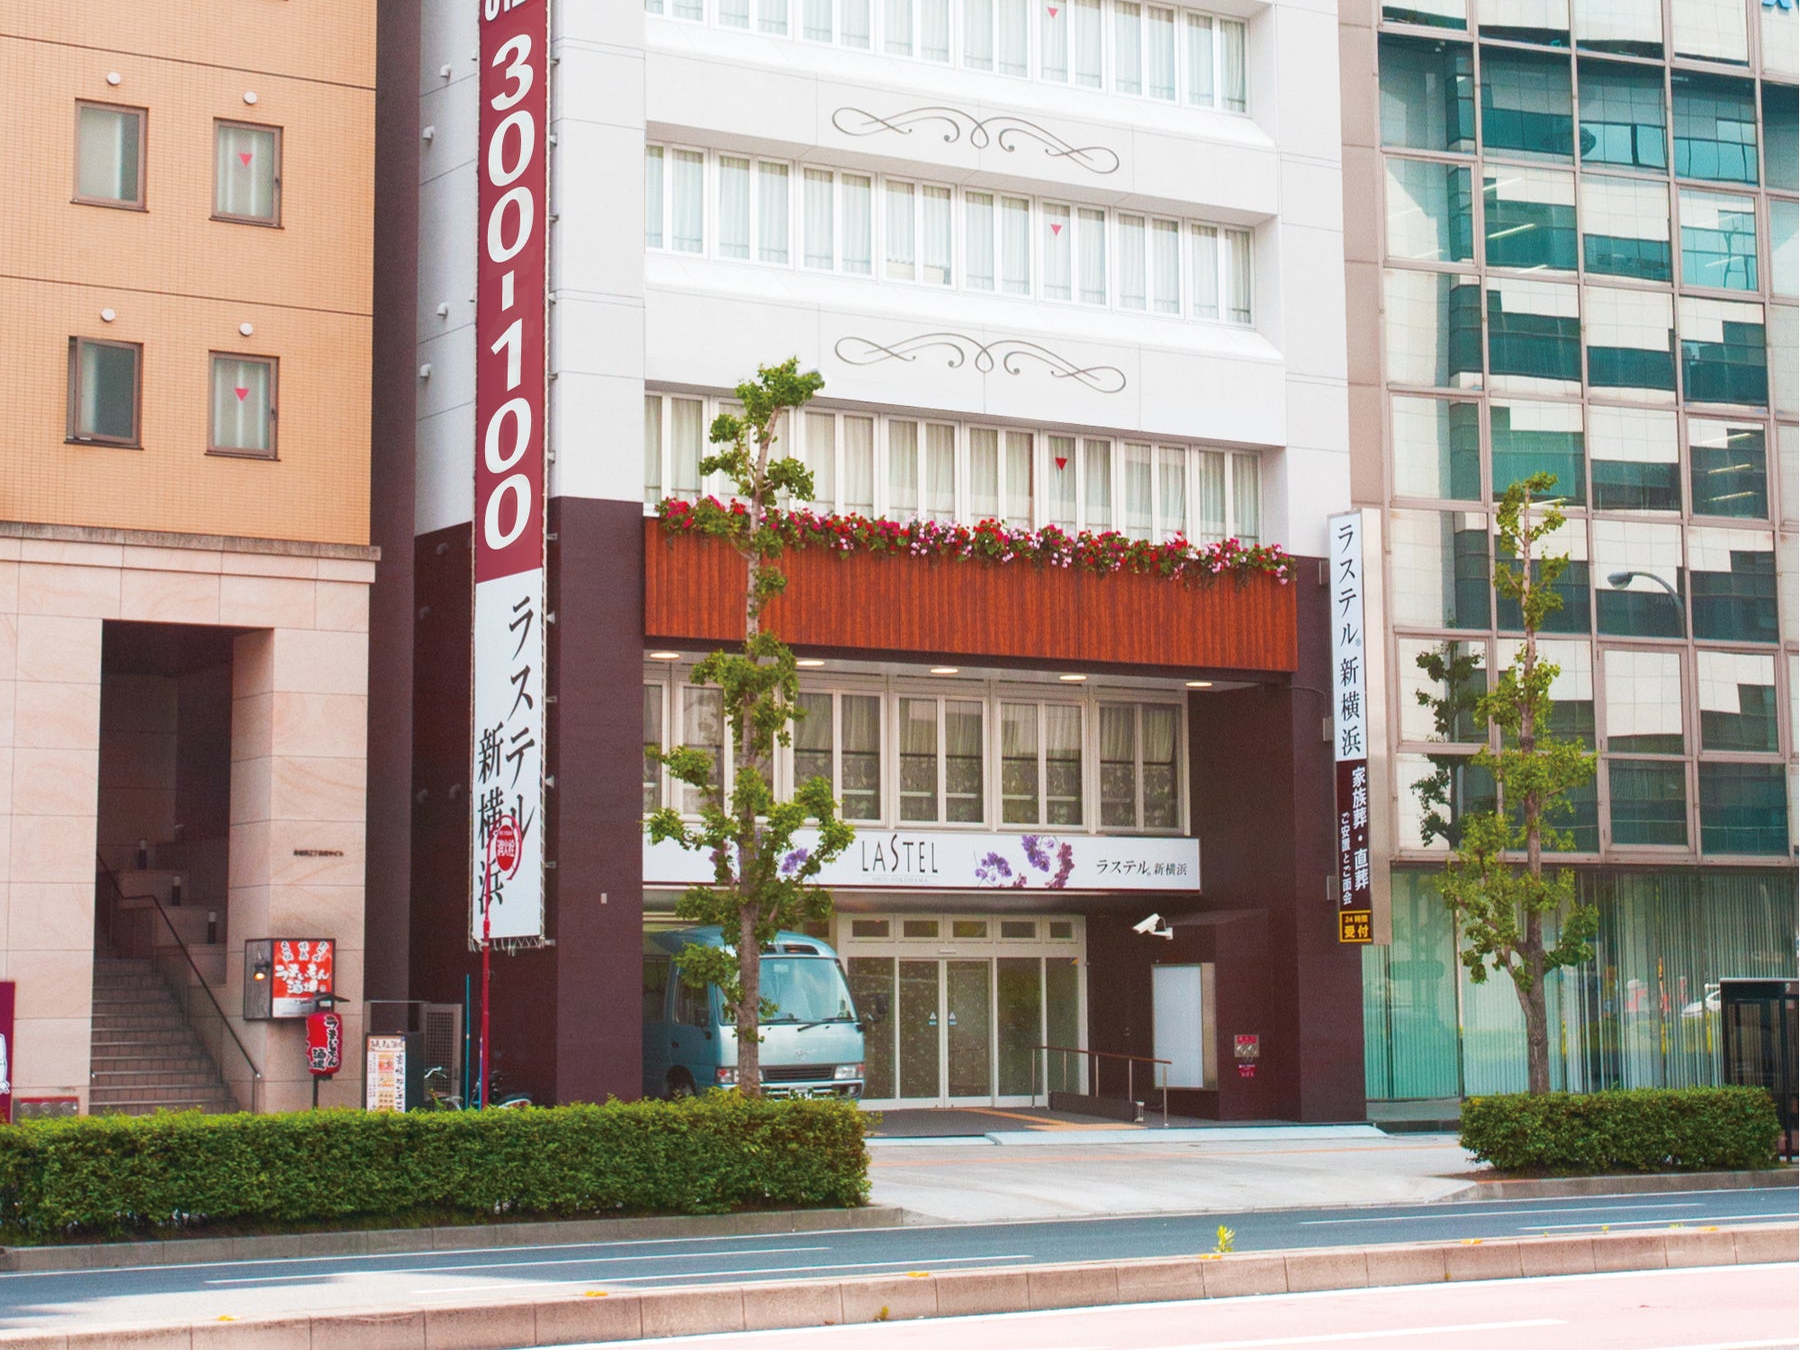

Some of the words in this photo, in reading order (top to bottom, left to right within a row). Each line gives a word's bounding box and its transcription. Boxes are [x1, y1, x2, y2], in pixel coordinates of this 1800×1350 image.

[483, 33, 535, 550] 300-1100
[505, 595, 535, 842] ラステル
[478, 721, 504, 915] 新横浜
[862, 833, 938, 873] LASTEL
[1352, 766, 1369, 891] 家族葬・直葬
[1344, 925, 1369, 939] 受付
